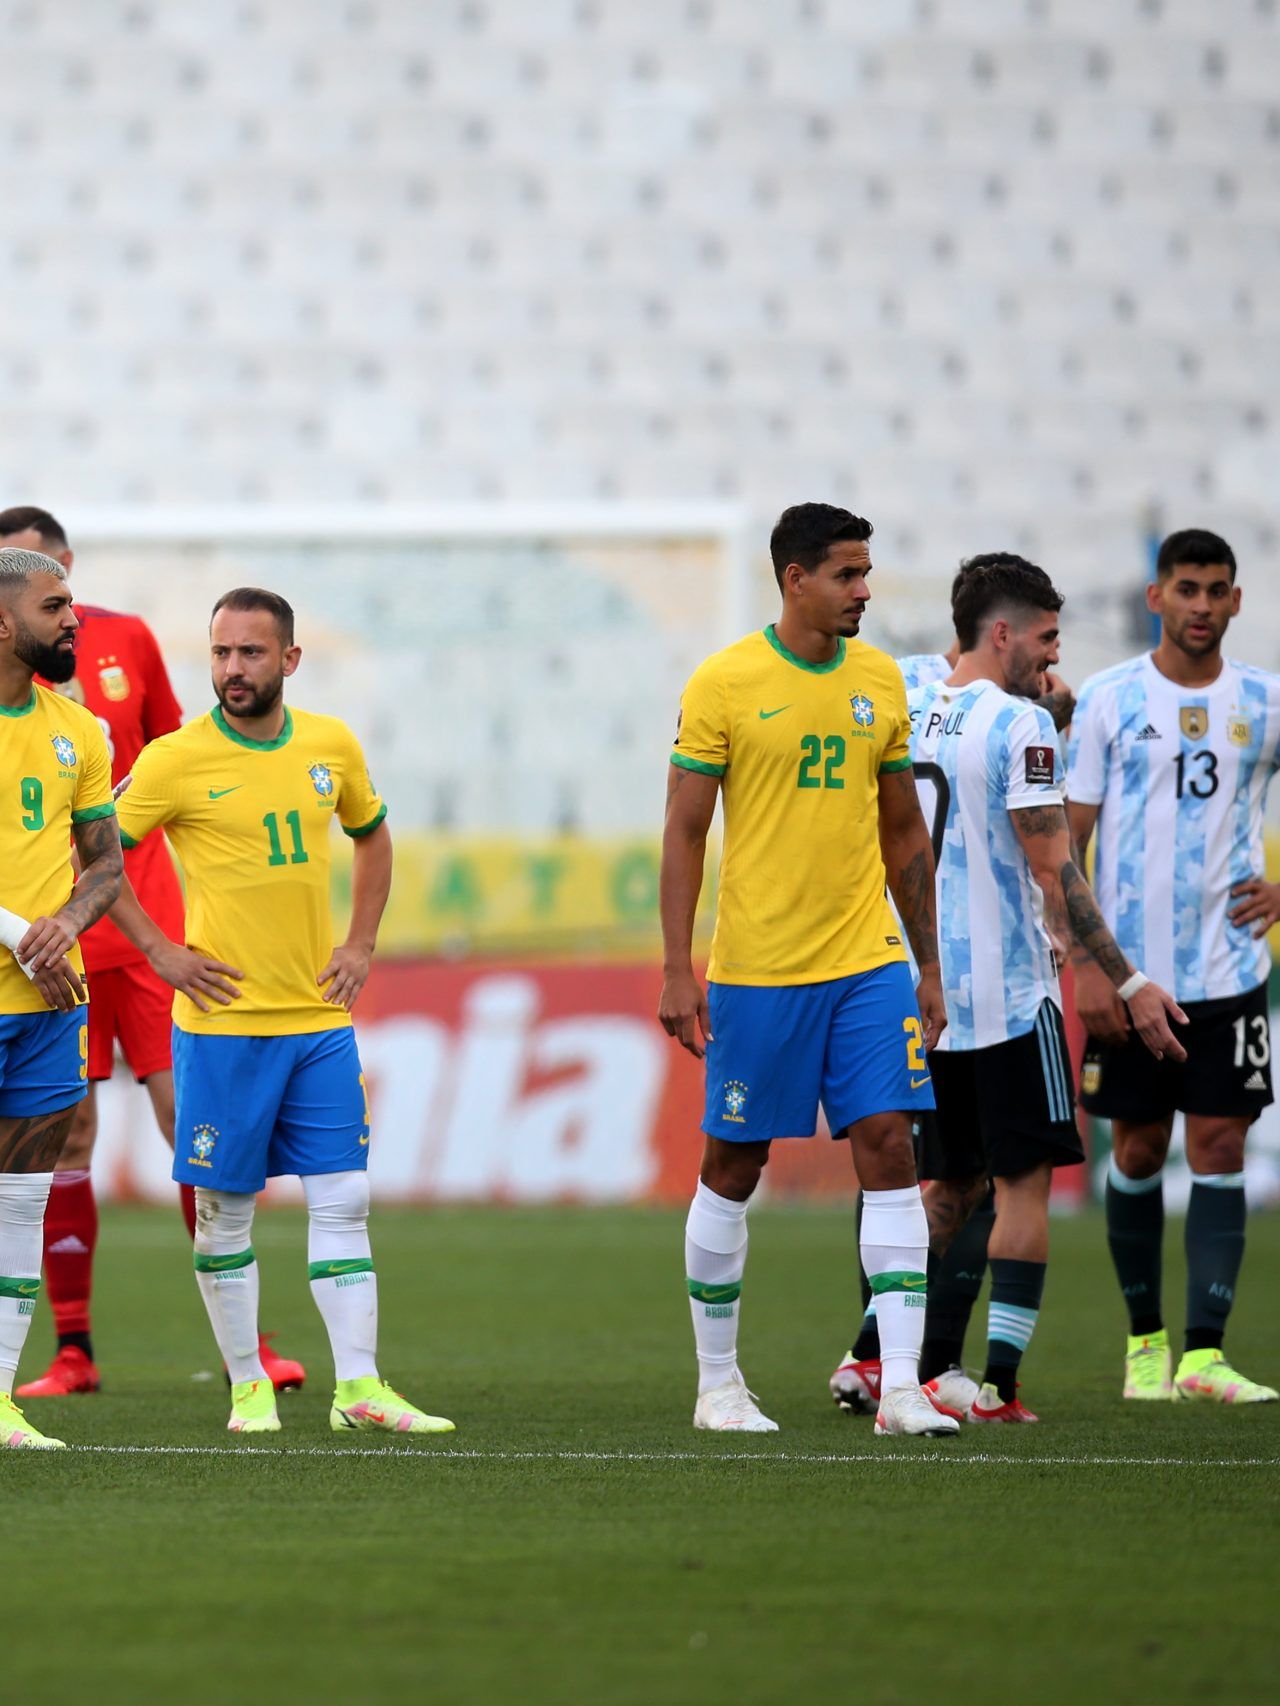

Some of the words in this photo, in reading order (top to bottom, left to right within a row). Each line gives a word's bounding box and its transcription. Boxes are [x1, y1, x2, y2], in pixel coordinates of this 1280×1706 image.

[851, 730, 875, 740] BRASIL
[925, 711, 963, 738] PAUL
[797, 735, 845, 789] 22
[1171, 750, 1219, 800] 13
[20, 776, 45, 831] 9
[263, 810, 309, 865] 11
[1232, 1014, 1271, 1068] 13
[722, 1114, 746, 1123] BRASIL
[188, 1157, 213, 1168] BRASIL
